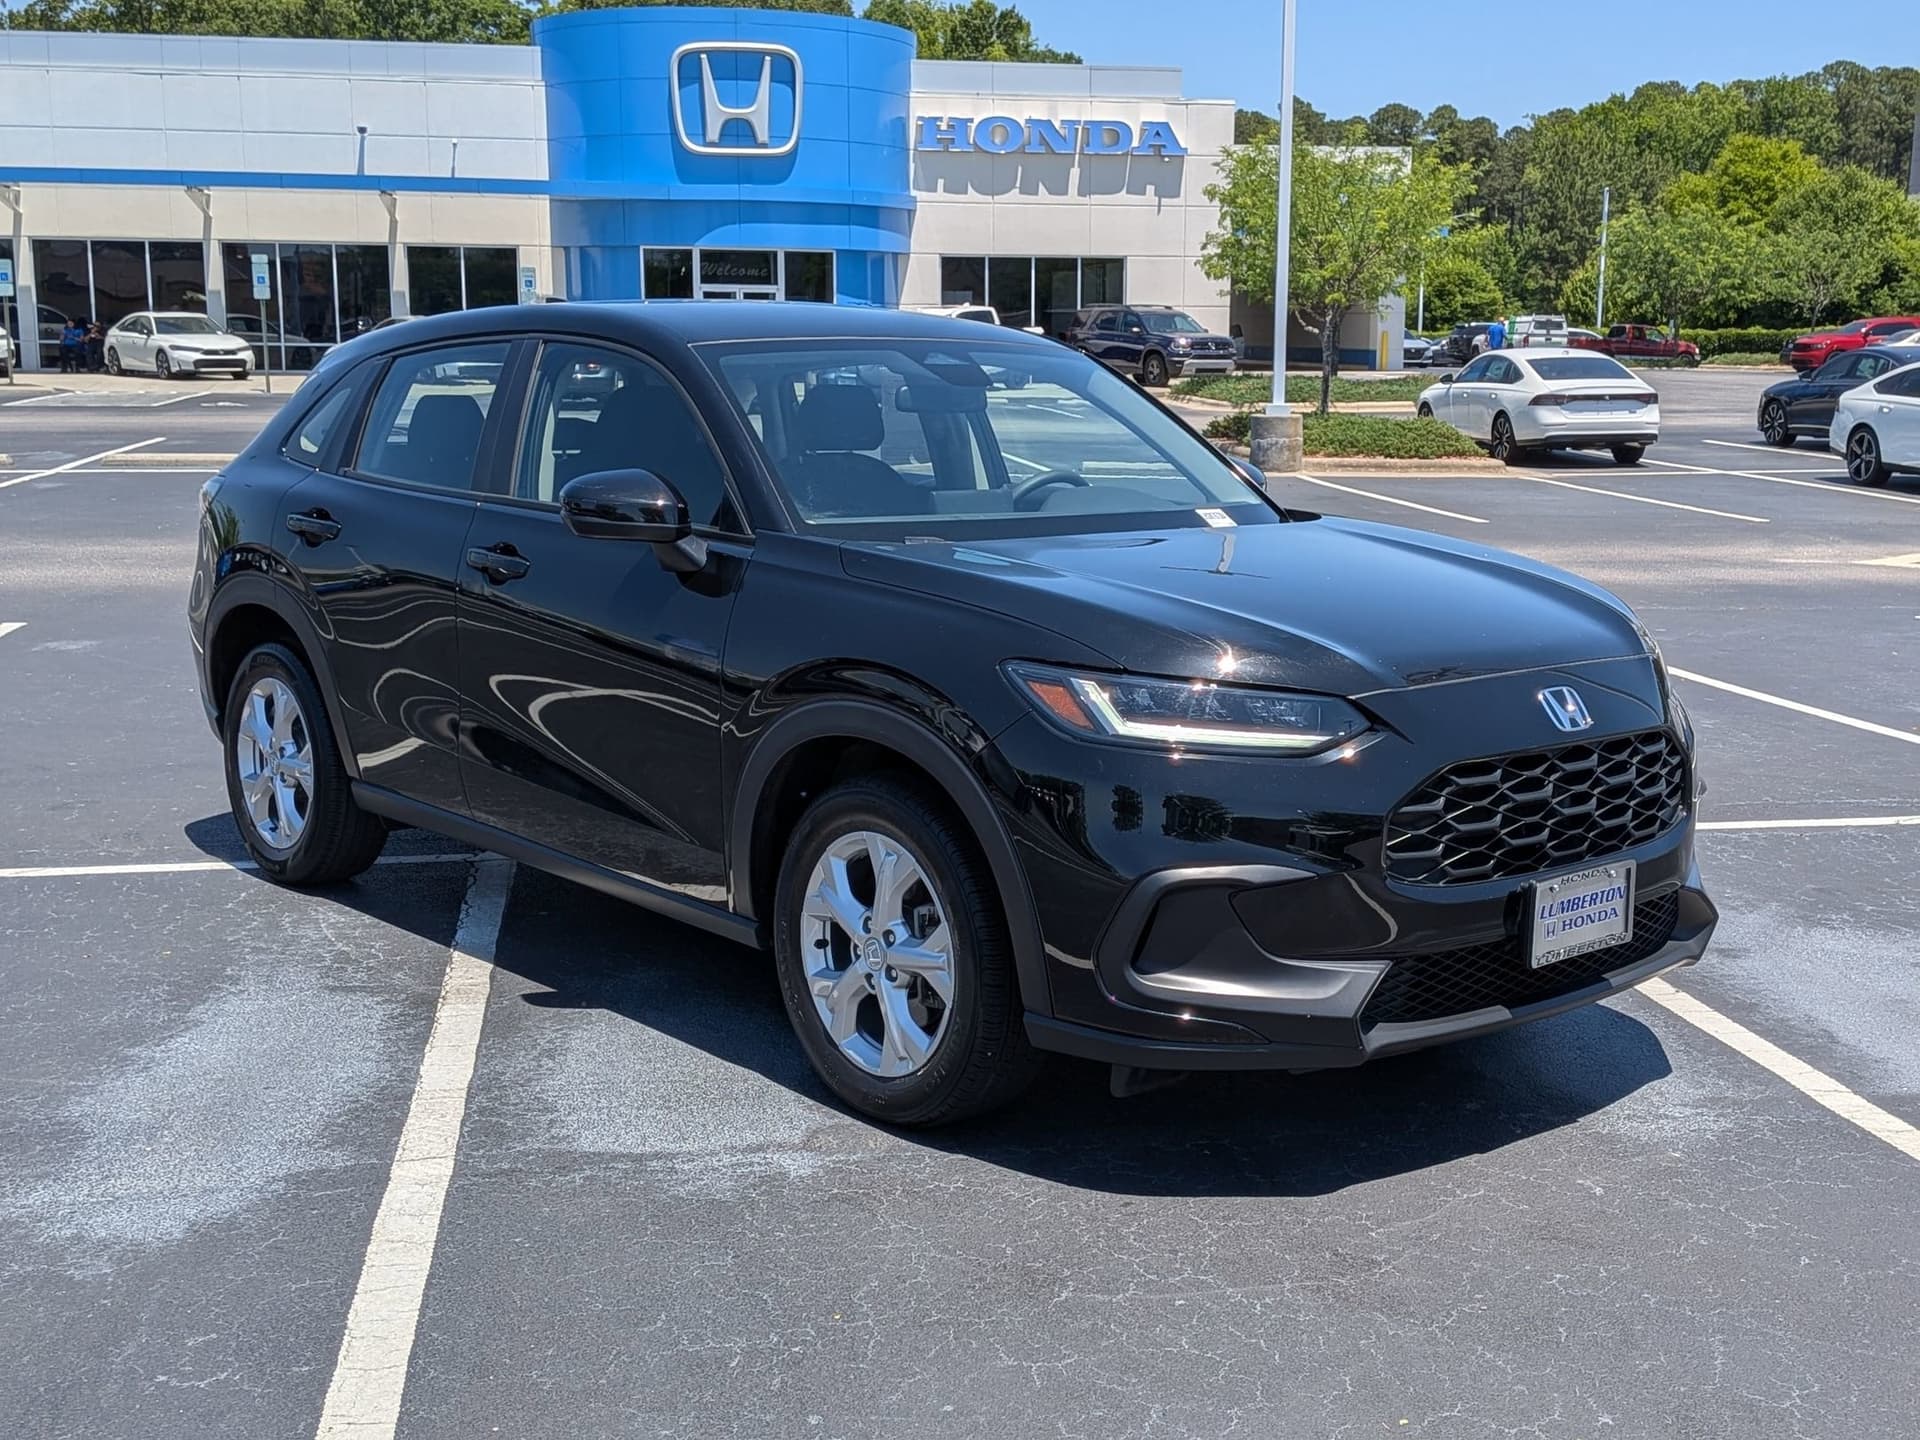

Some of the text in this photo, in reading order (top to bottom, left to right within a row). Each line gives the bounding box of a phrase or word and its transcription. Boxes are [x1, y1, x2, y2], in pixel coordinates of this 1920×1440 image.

[916, 116, 1188, 155] HONDA
[701, 262, 769, 277] Welcome
[1560, 867, 1609, 885] HONDA
[1540, 885, 1627, 920] LUMBERTON
[1560, 907, 1619, 932] HONDA
